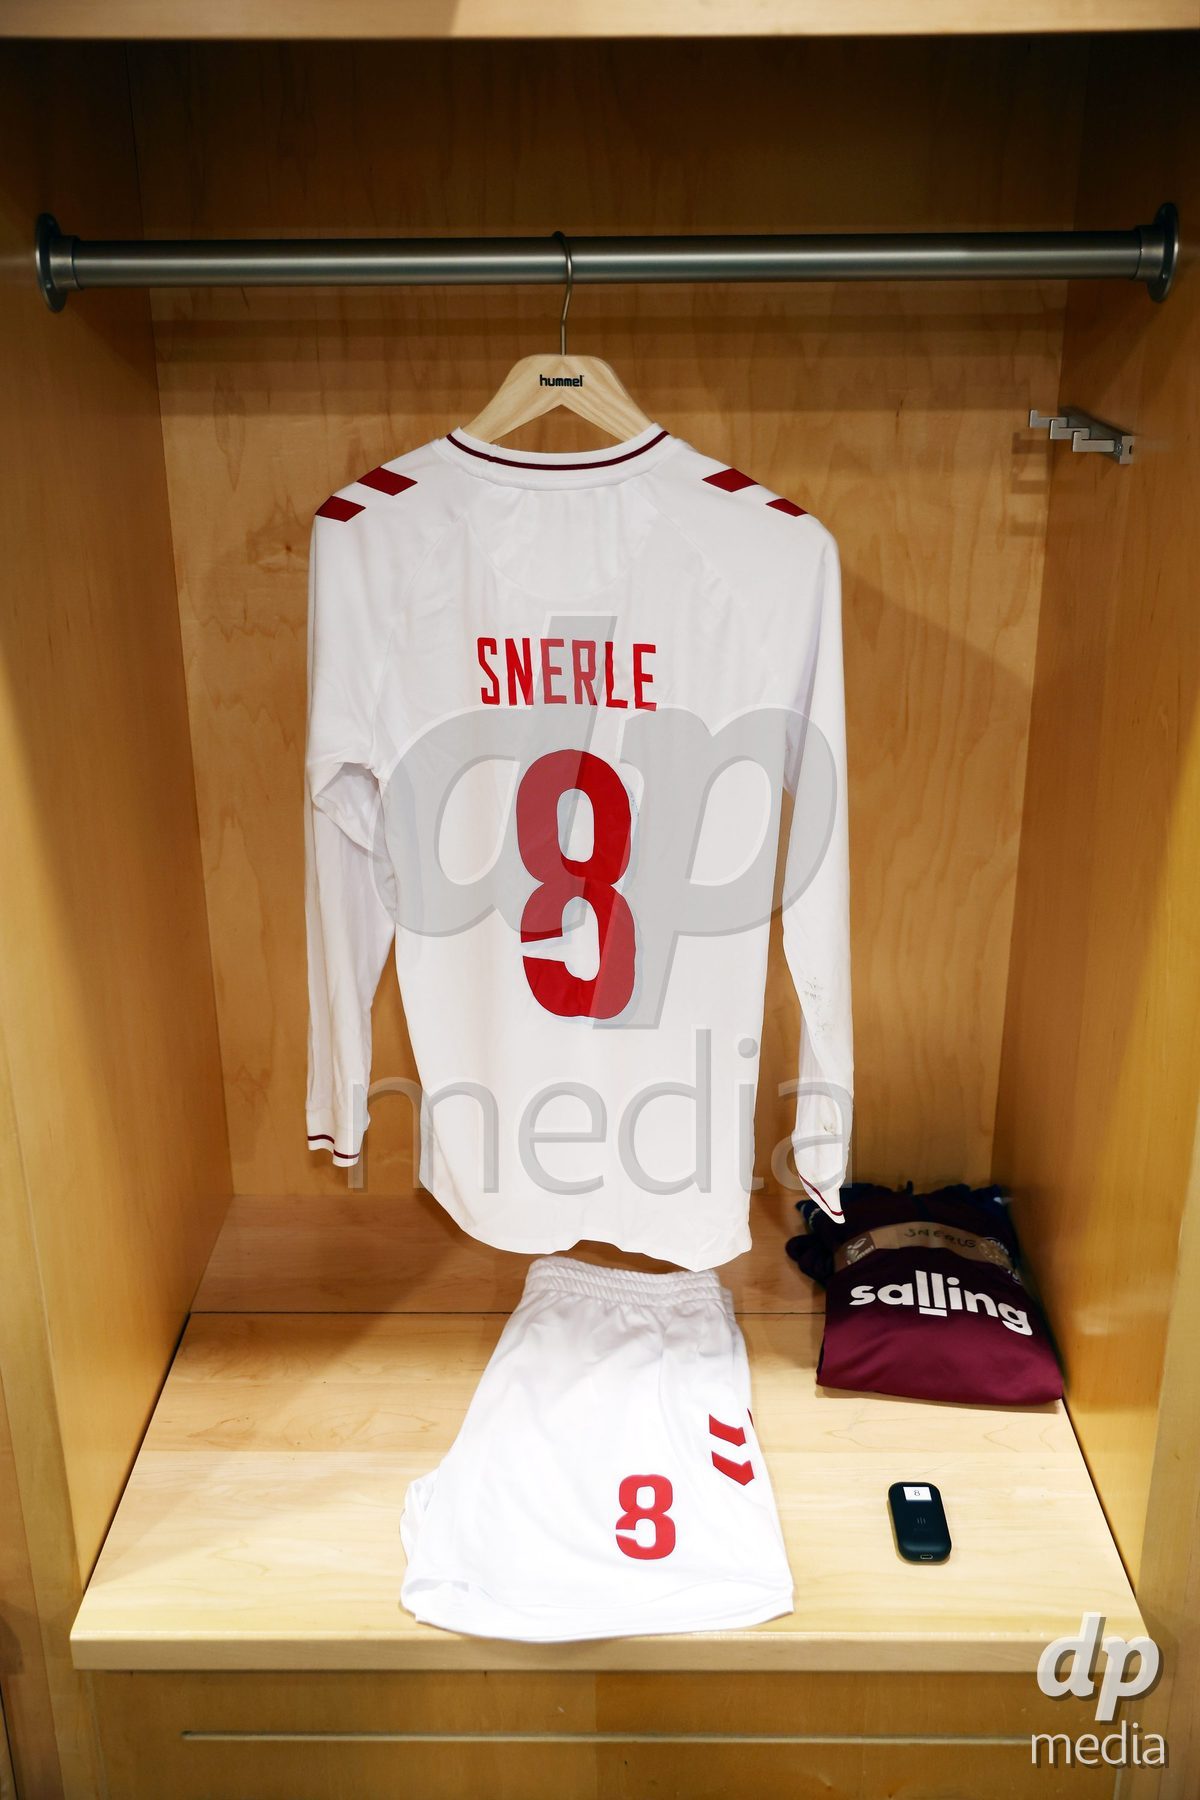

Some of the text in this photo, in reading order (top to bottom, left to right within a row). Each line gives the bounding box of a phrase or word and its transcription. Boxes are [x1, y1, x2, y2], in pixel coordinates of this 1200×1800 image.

[539, 374, 583, 387] hummel
[477, 637, 657, 711] SNERLE
[516, 748, 636, 1020] 8
[849, 1270, 1033, 1336] salling
[615, 1474, 676, 1560] 8
